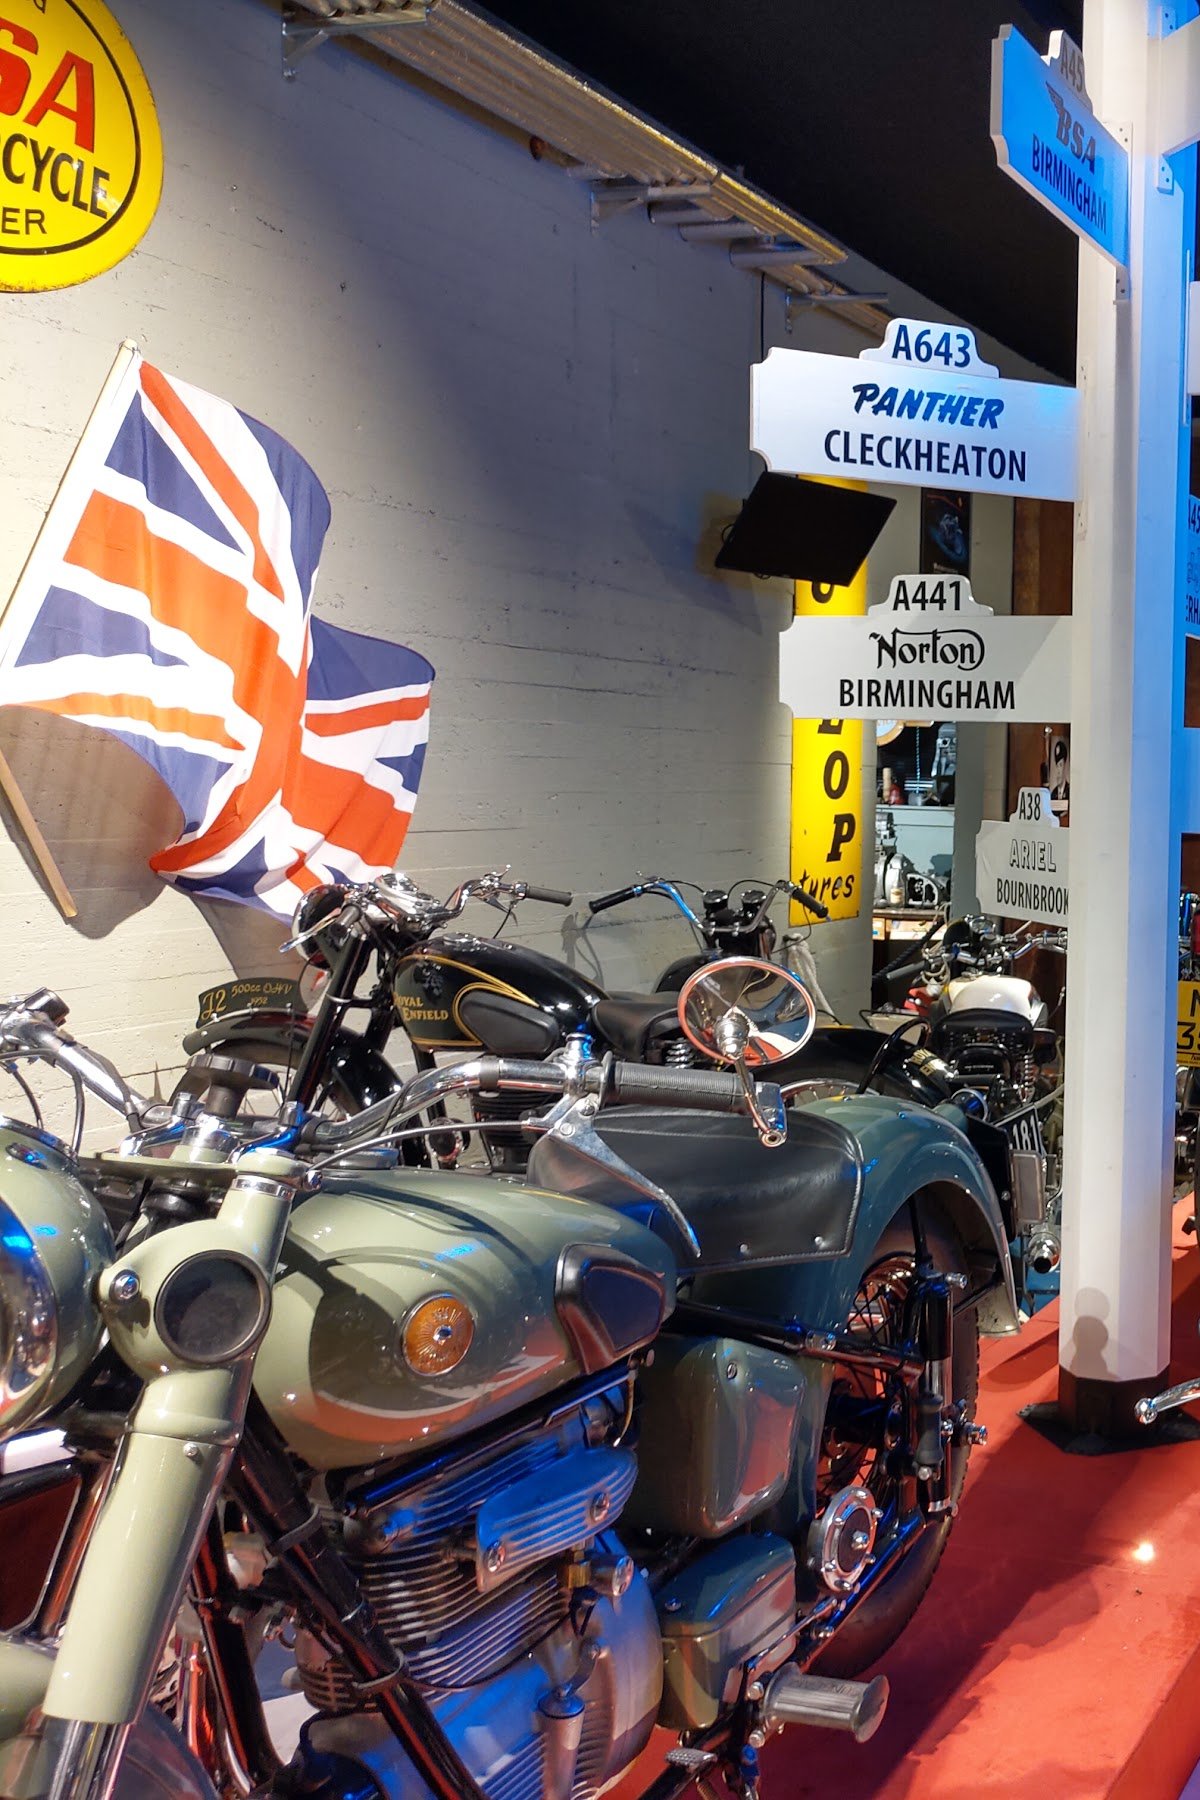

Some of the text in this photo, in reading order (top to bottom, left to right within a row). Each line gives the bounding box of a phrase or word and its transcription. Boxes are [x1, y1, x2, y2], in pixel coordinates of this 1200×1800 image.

[1060, 44, 1085, 92] A45
[1054, 104, 1096, 174] BSA
[1032, 133, 1106, 235] BIRMINGHAM
[892, 324, 971, 367] A643
[851, 383, 1004, 429] PANTHER
[824, 429, 1027, 482] CLECKHEATON
[893, 581, 961, 611] A441
[869, 628, 984, 671] Norton
[840, 679, 1016, 709] BIRMINGHAM
[1019, 791, 1041, 821] A38
[1009, 839, 1057, 872] ARIEL
[231, 984, 261, 997] 500cc
[392, 992, 423, 1007] ROYAL
[402, 1007, 449, 1021] ENFIELD
